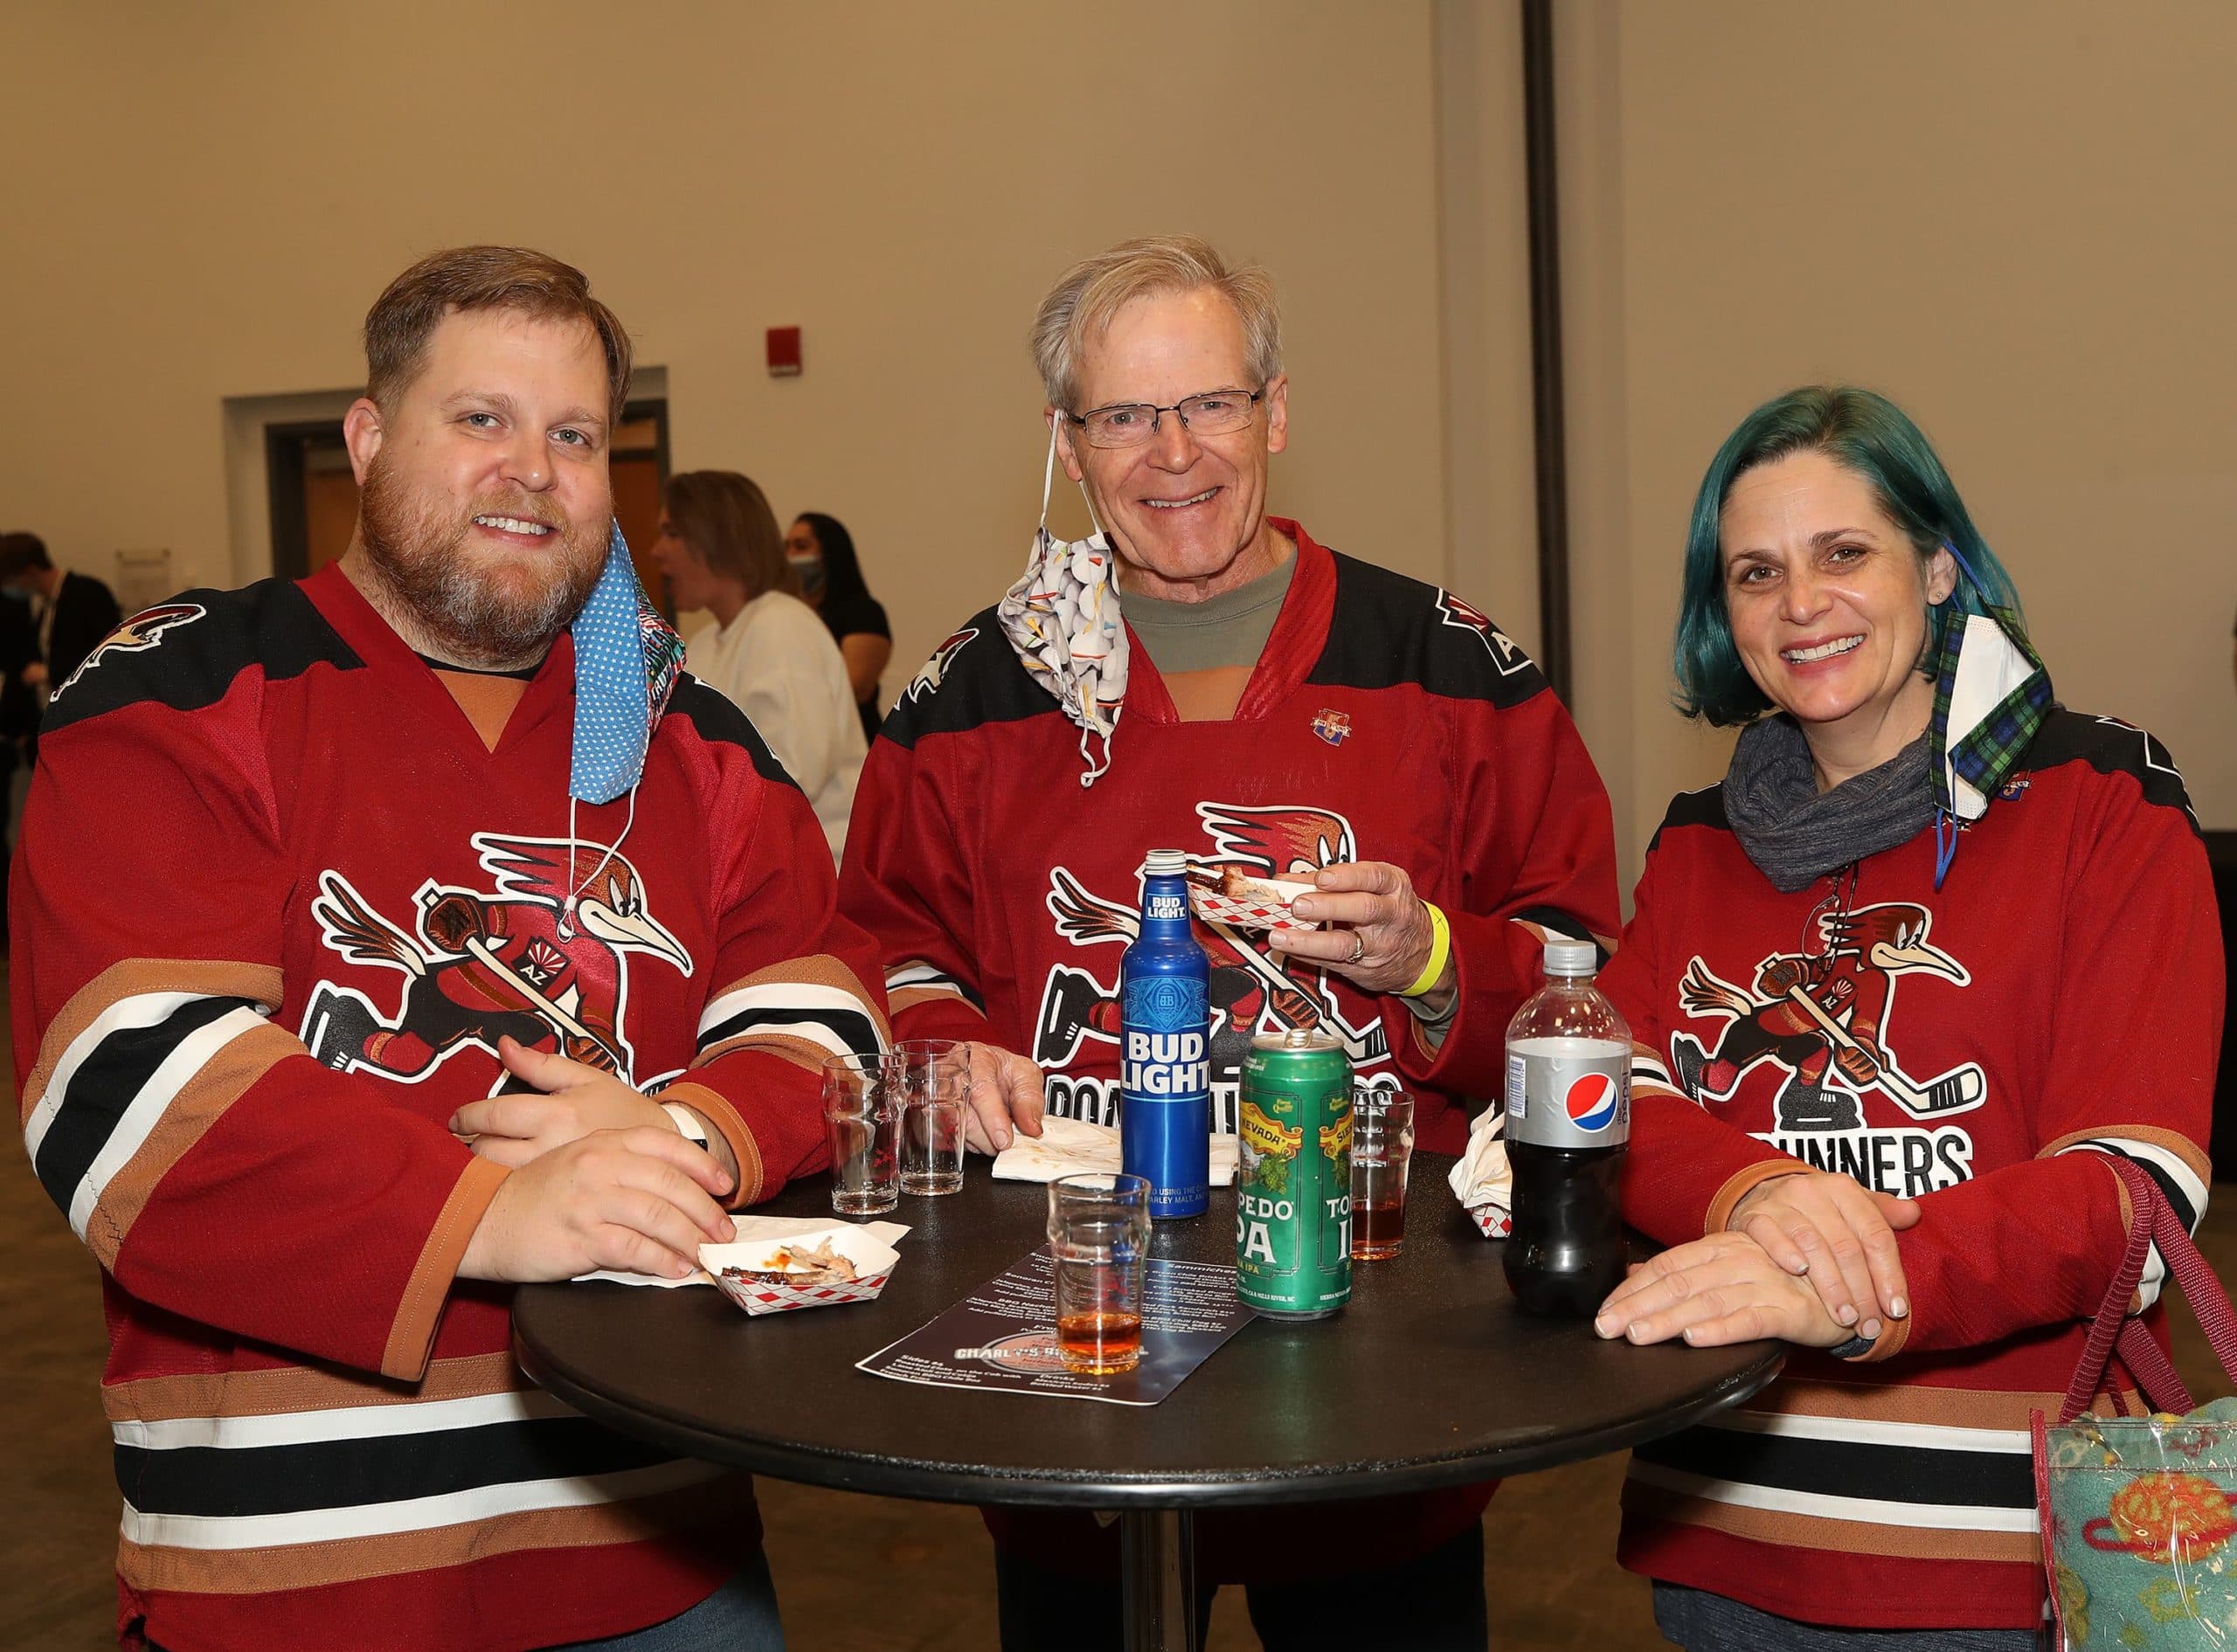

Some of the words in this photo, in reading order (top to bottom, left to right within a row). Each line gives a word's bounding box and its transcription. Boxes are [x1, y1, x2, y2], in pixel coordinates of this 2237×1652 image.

[1153, 896, 1181, 908] BUD
[519, 964, 548, 985] AZ
[1822, 995, 1838, 1009] AZ
[1128, 1032, 1203, 1063] BUD
[1121, 1060, 1210, 1095] LIGHT
